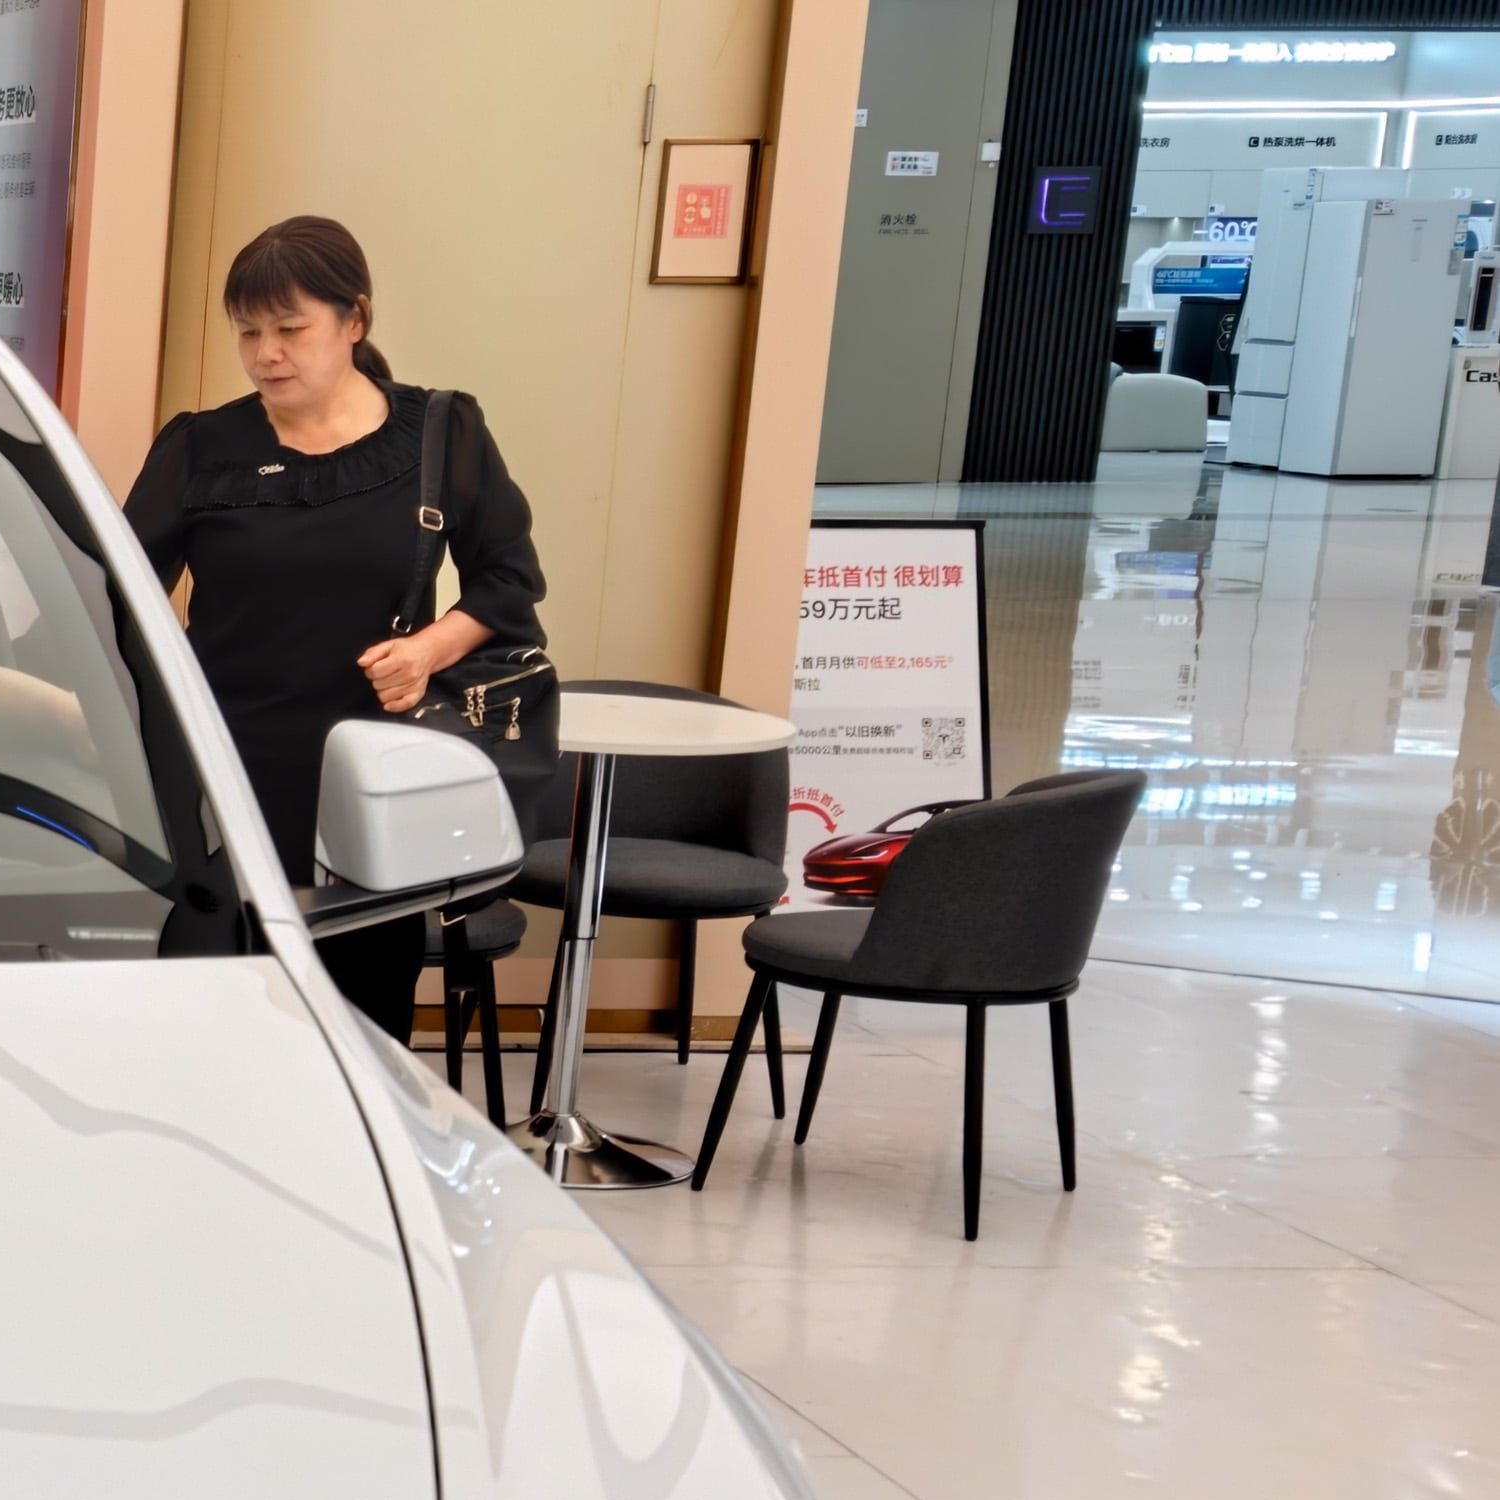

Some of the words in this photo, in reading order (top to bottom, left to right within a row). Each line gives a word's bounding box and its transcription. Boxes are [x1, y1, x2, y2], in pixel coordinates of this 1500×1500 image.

[1262, 136, 1337, 148] 热泵洗烘一体机
[880, 213, 917, 226] 消火栓
[894, 564, 964, 588] 很划算
[790, 786, 846, 818] 折抵首付
